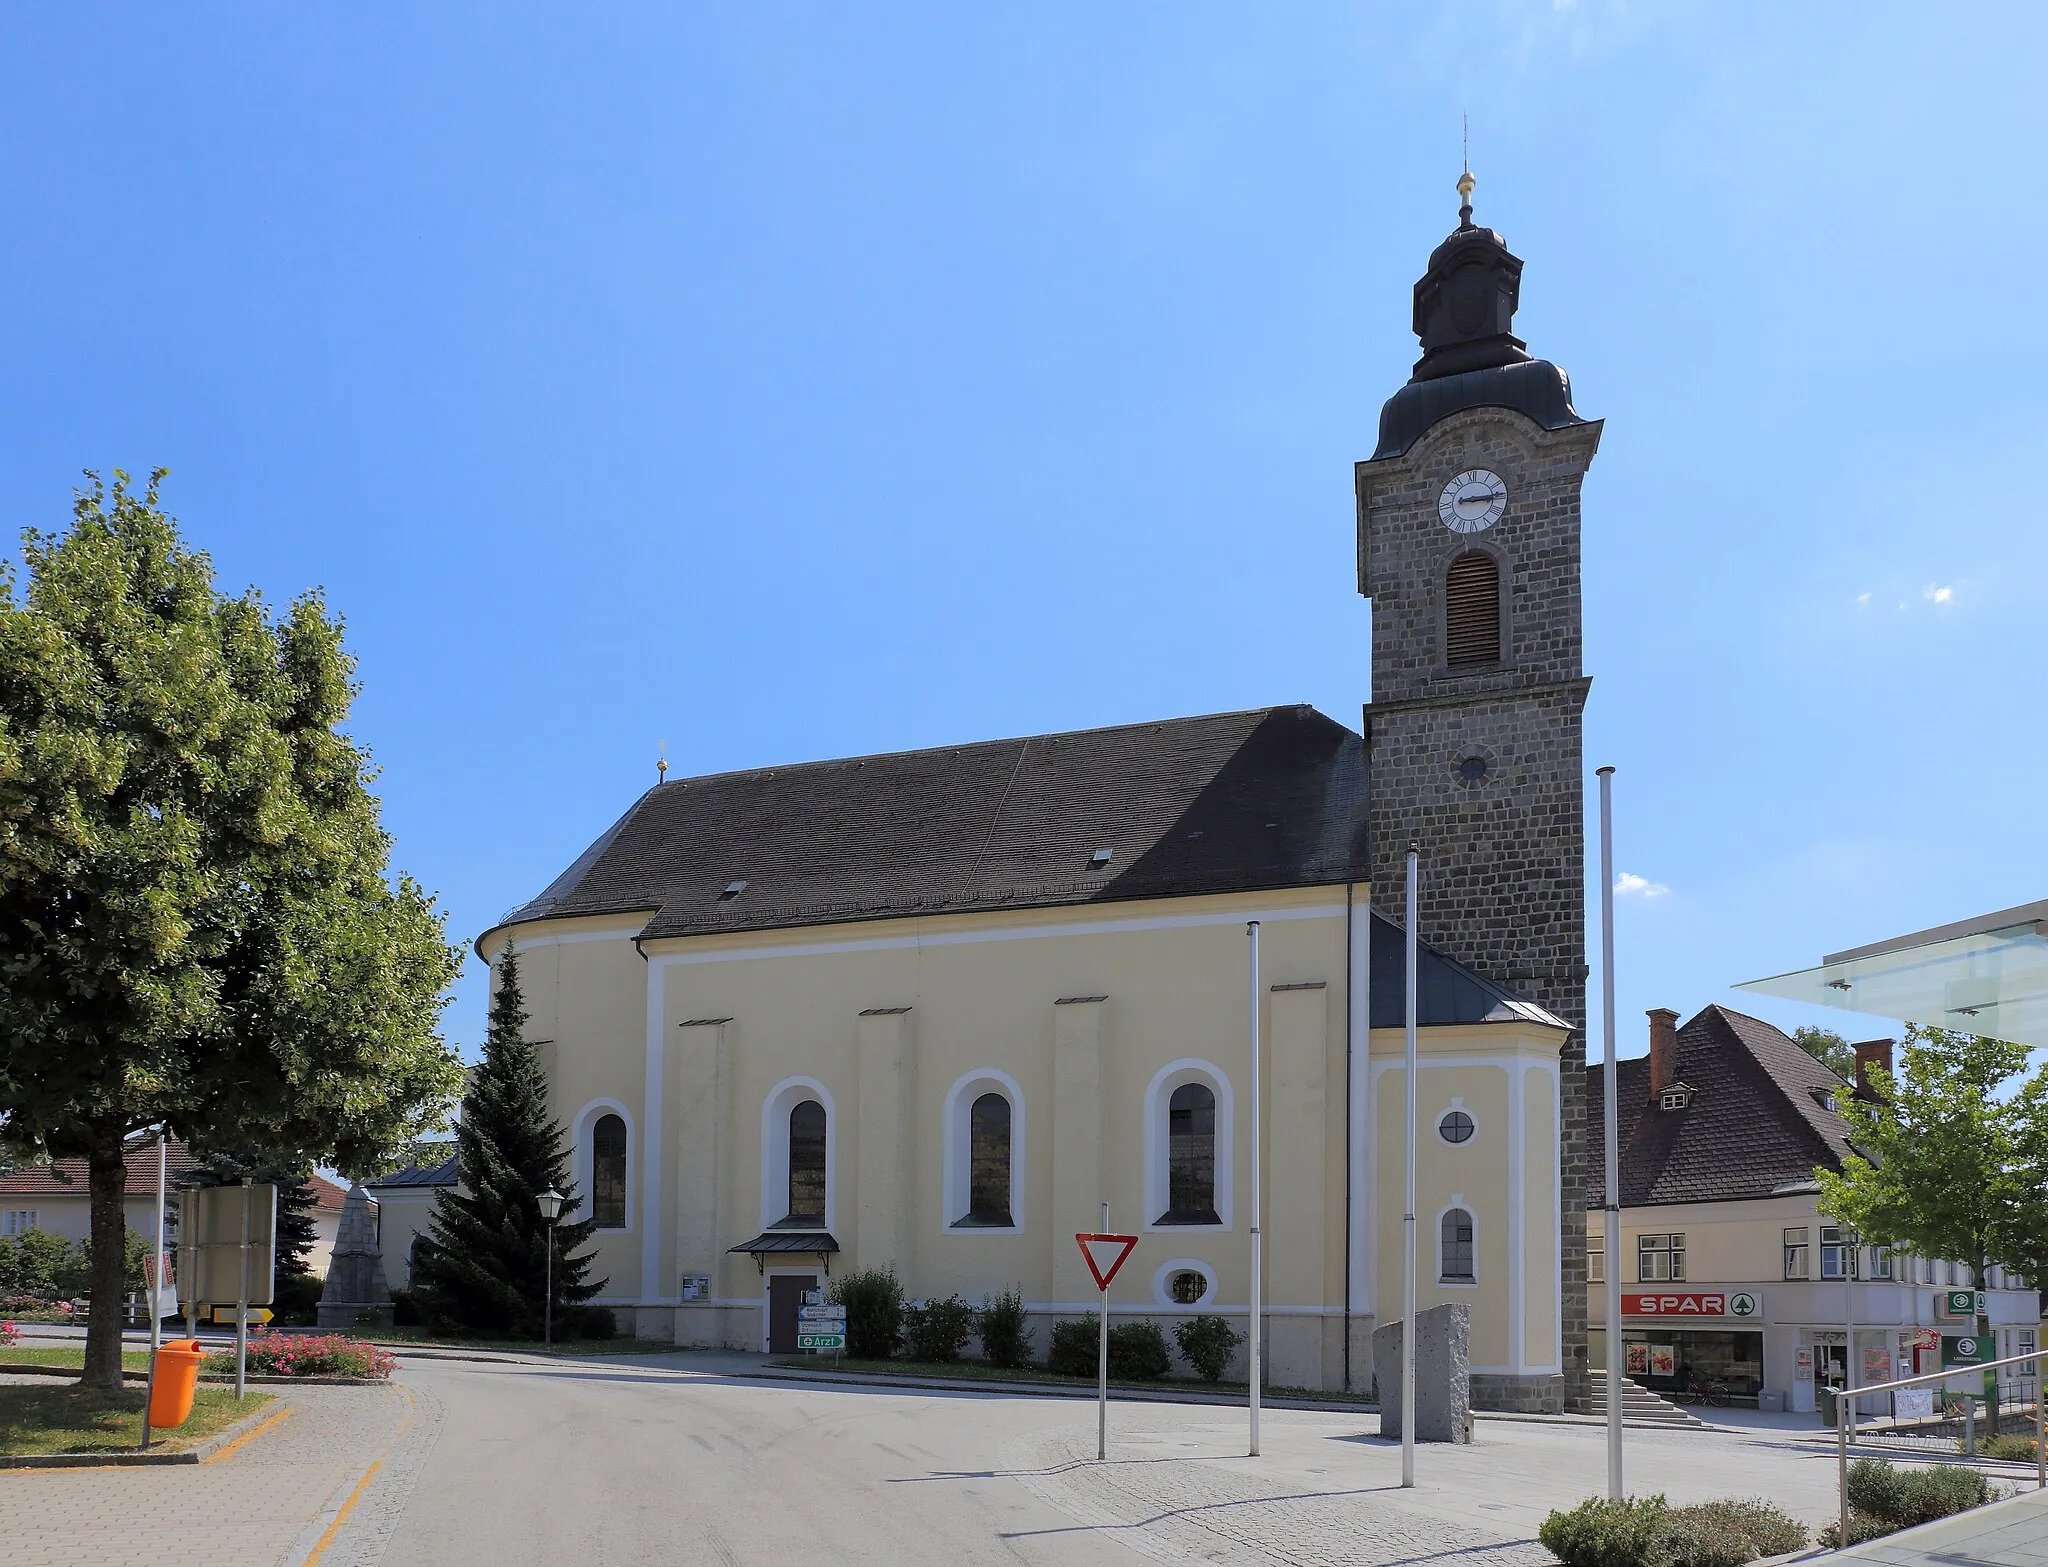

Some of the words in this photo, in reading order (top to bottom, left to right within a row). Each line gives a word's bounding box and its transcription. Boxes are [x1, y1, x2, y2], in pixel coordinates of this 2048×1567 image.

[1467, 471, 1478, 482] XII
[1483, 472, 1491, 483] I
[1451, 477, 1463, 489] XI
[1490, 479, 1502, 489] II
[1443, 489, 1454, 497] X
[1440, 501, 1452, 511] IX
[1442, 512, 1457, 527] VIII
[1483, 517, 1492, 528] V
[1454, 520, 1466, 532] VII
[1469, 521, 1478, 532] VI
[1640, 1296, 1723, 1313] SPAR
[814, 1337, 835, 1346] Arzt
